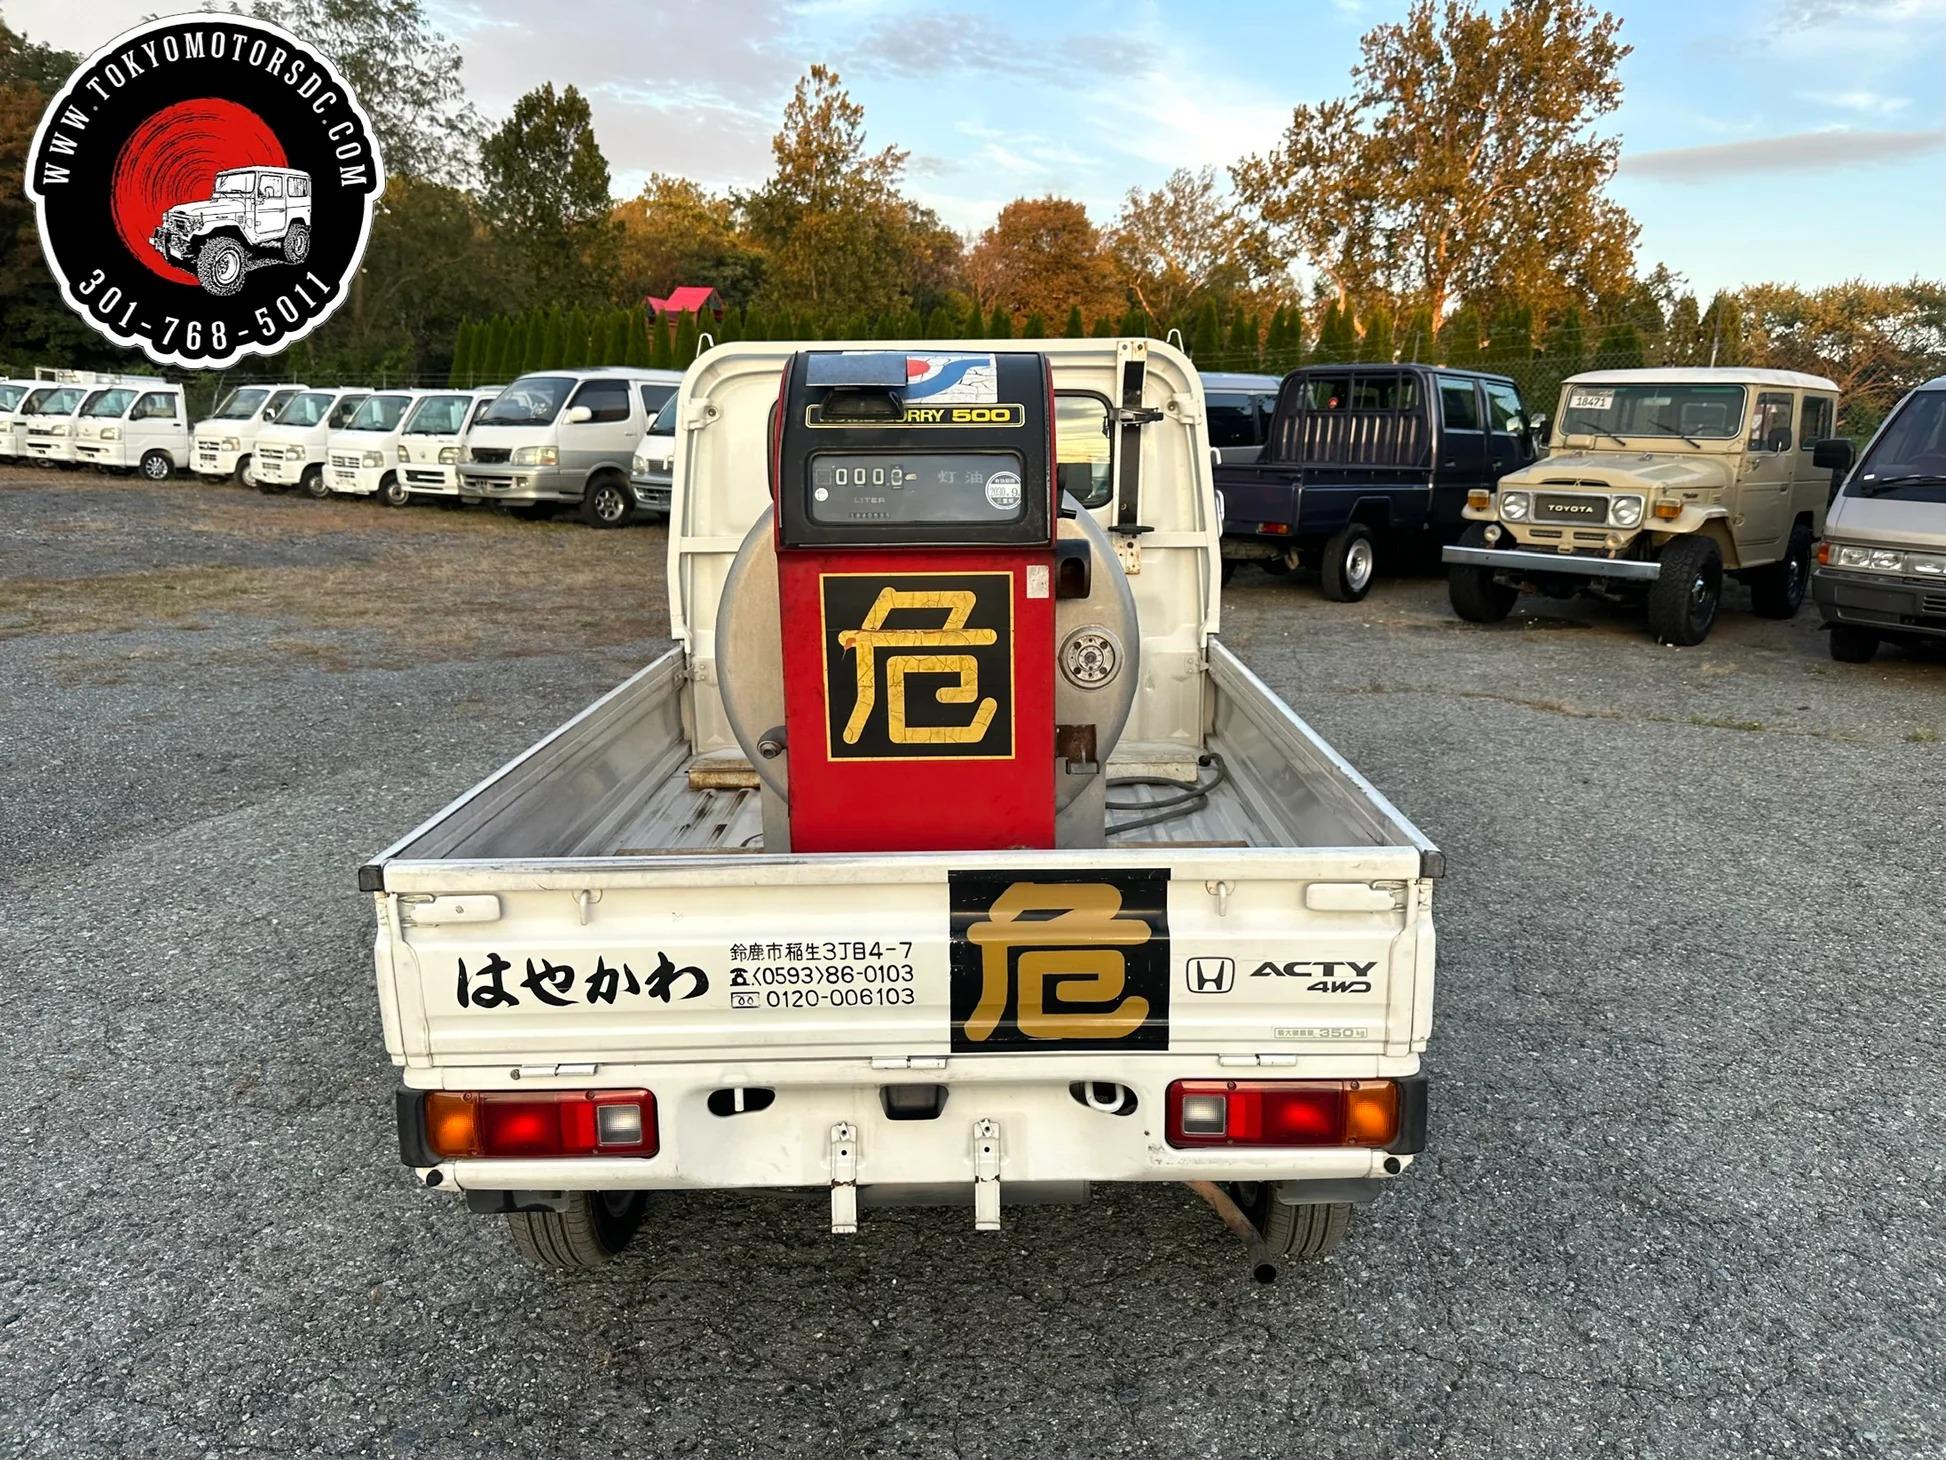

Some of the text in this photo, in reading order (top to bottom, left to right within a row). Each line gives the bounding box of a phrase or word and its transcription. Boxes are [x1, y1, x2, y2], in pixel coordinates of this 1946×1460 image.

[1576, 396, 1606, 408] 18471
[952, 409, 1010, 422] 500
[1547, 504, 1594, 513] TOYOTA
[838, 587, 998, 745] 危
[963, 882, 1152, 1042] 危
[1250, 961, 1379, 977] ACTY
[456, 951, 710, 1008] はやかわ
[1307, 981, 1372, 993] 4WD
[766, 988, 915, 1008] 0120-006103
[1320, 1028, 1354, 1038] 350
